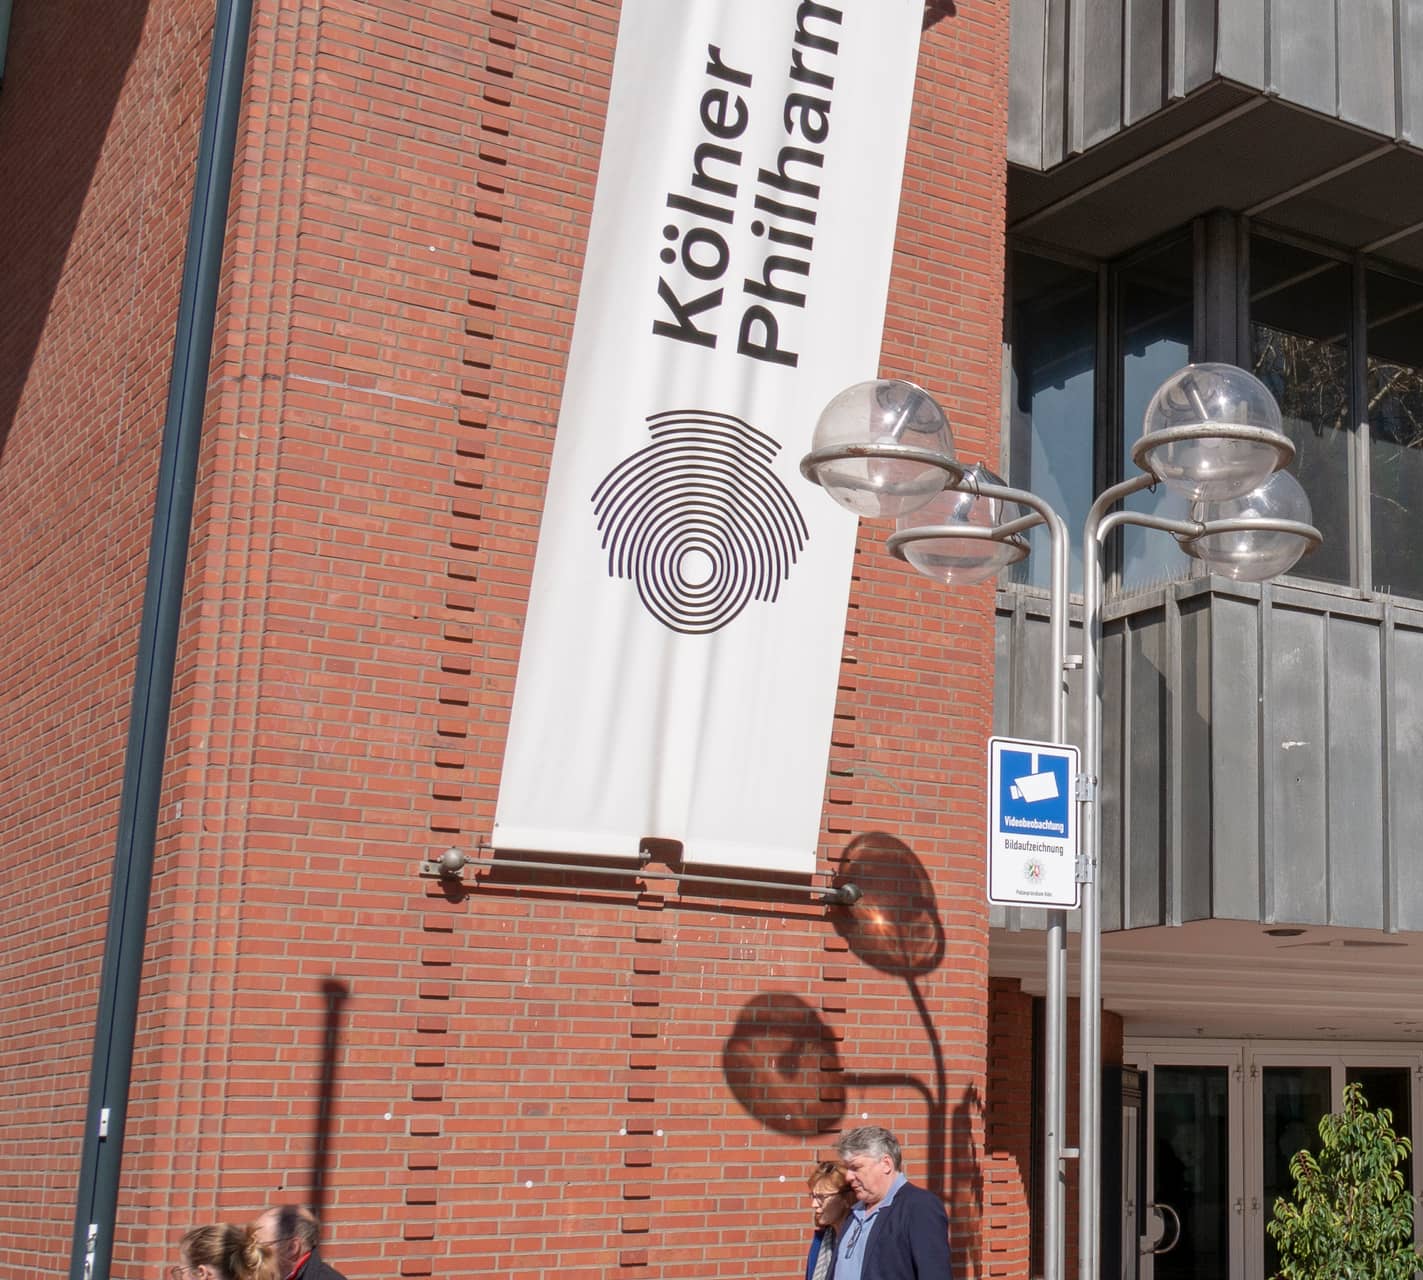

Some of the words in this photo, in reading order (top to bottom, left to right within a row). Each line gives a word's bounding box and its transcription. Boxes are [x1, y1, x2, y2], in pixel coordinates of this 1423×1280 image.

[652, 44, 752, 348] Kölner
[1004, 815, 1064, 833] Videobeobachtung
[1004, 839, 1064, 856] Bildaufzeichnung
